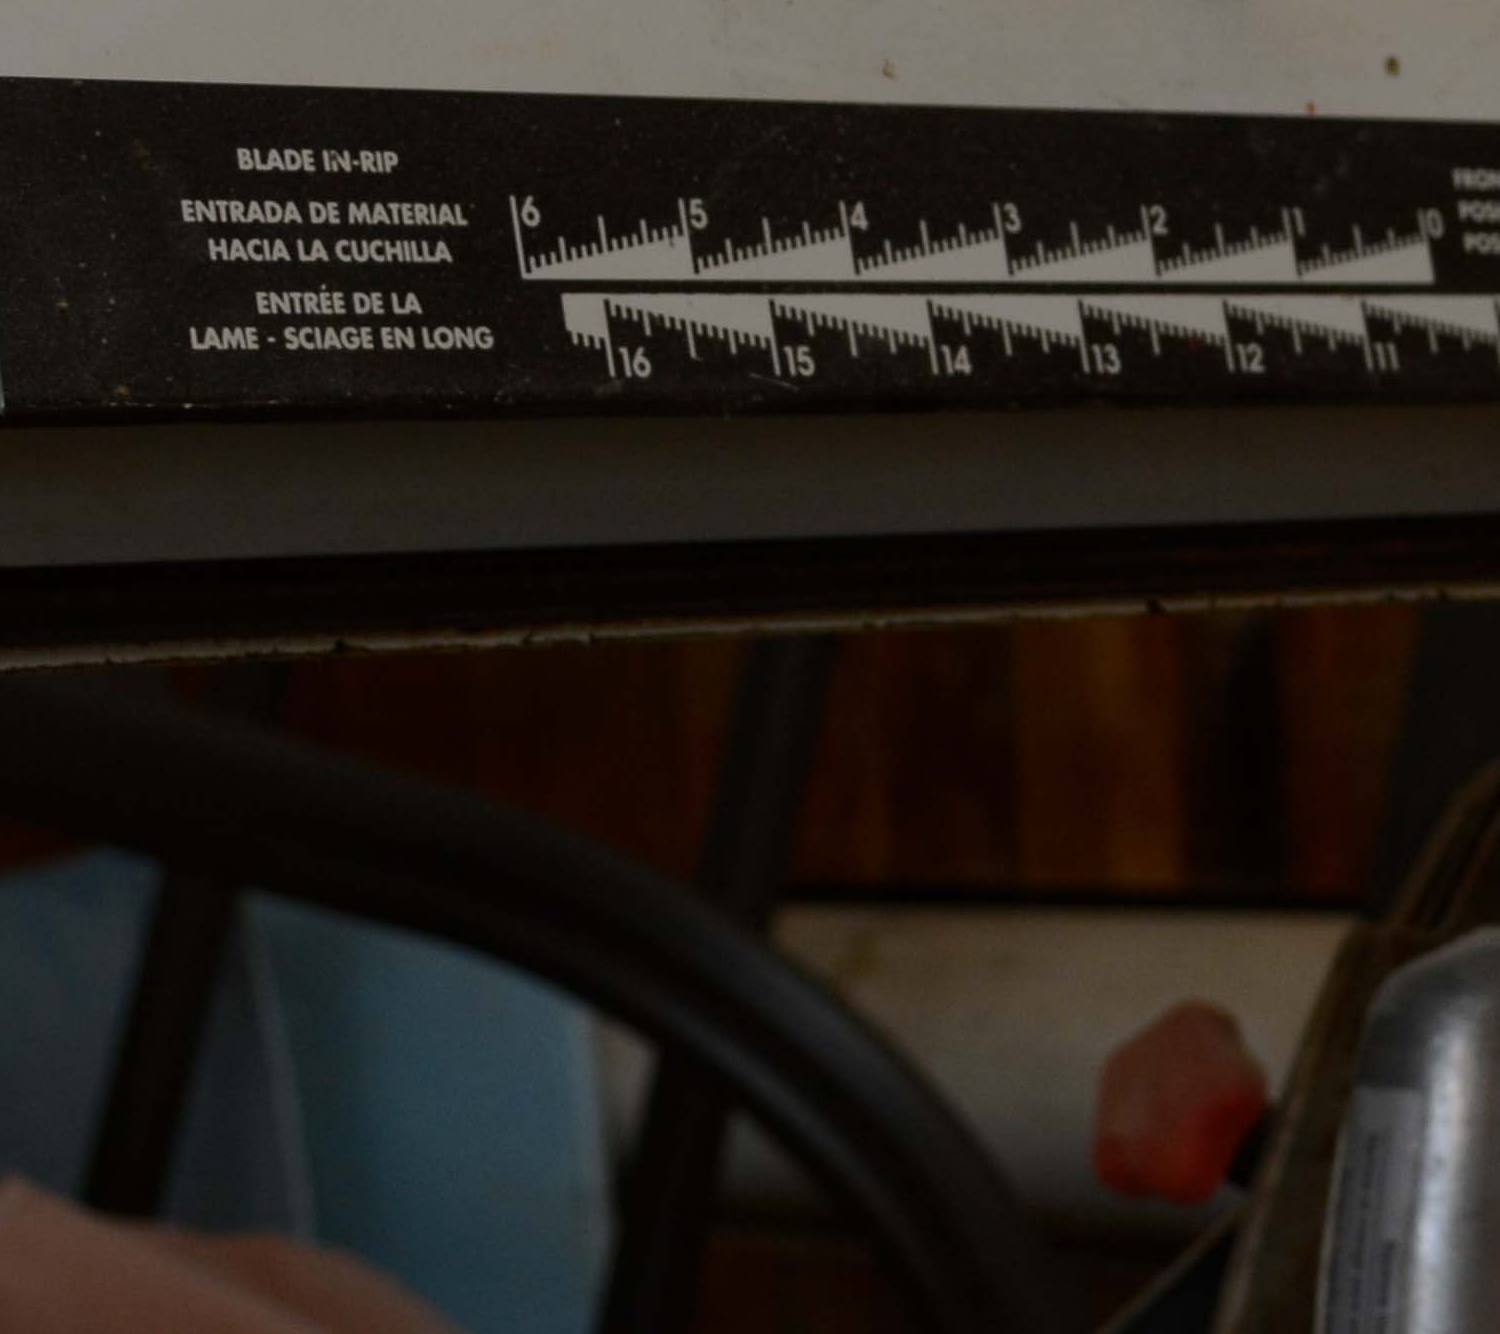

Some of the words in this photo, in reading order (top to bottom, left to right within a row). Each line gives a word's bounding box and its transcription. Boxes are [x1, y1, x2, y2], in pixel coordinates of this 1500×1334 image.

[236, 147, 317, 172] BLADE
[321, 149, 399, 174] IN-RIP
[180, 199, 303, 224] ENTRADA
[308, 200, 341, 225] DE
[348, 202, 469, 226] MATERIAL
[520, 195, 541, 228] 6
[689, 197, 709, 230] 5
[849, 201, 869, 231] 4
[1000, 202, 1022, 238] 3
[1148, 204, 1168, 238] 2
[207, 237, 292, 262] HACIA
[296, 238, 330, 262] LA
[334, 238, 453, 263] CUCHILLA
[255, 283, 347, 315] ENTRÉE
[352, 291, 385, 315] DE
[390, 292, 423, 315] LA
[189, 326, 260, 351] LAME
[283, 326, 375, 351] SCIAGE
[380, 326, 416, 350] EN
[421, 326, 495, 350] LONG
[618, 346, 652, 379] 16
[783, 345, 816, 377] 15
[940, 344, 973, 375] 14
[1087, 343, 1122, 375] 13
[1235, 342, 1265, 374] 12
